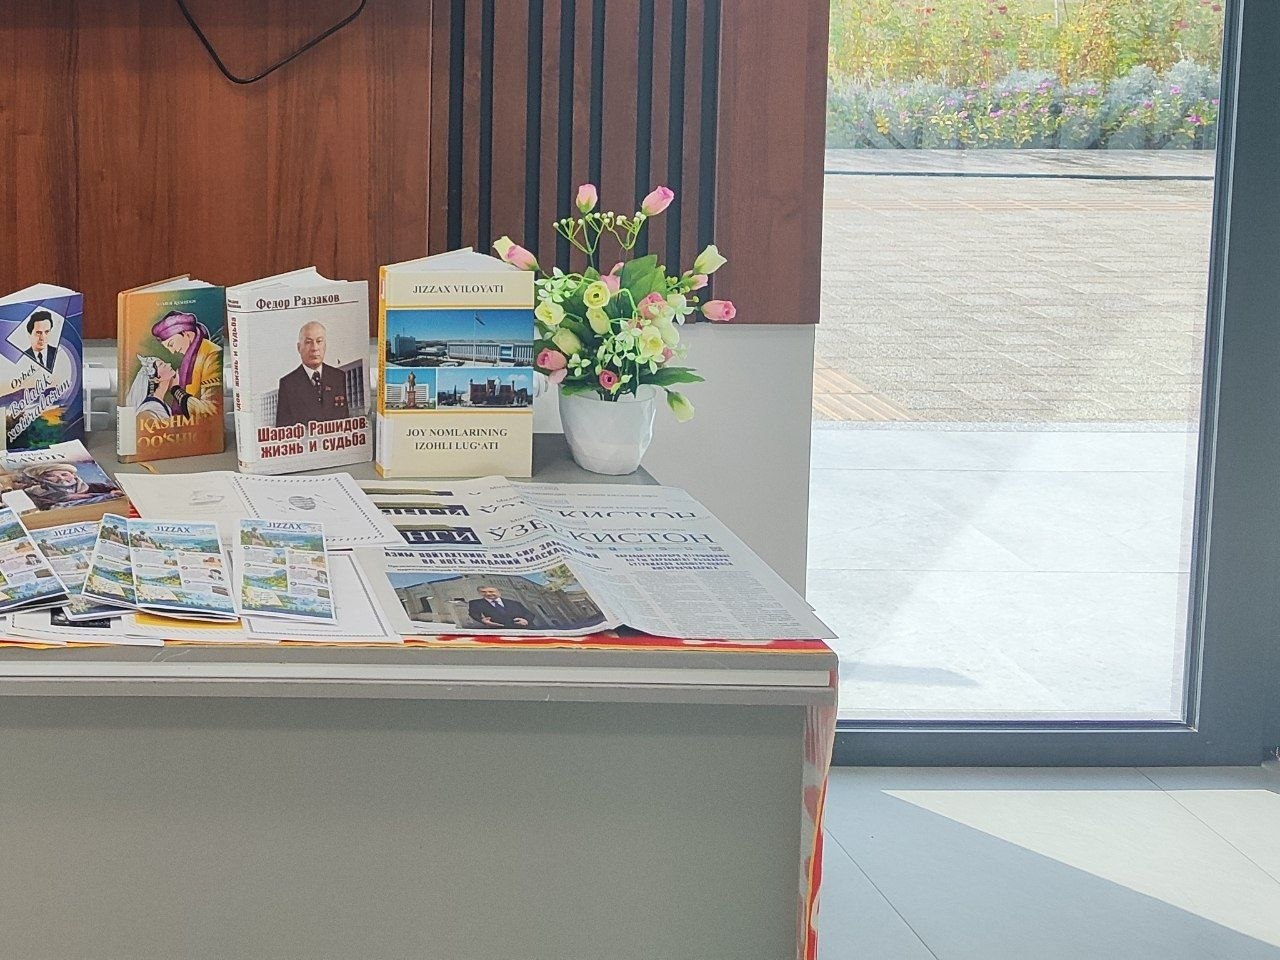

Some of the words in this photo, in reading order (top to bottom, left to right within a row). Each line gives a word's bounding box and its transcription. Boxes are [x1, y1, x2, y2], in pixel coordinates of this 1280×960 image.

[412, 285, 451, 294] JIZZAX
[453, 284, 504, 294] VILOYATI
[256, 296, 290, 311] Федор
[293, 293, 340, 307] Раззаков
[10, 365, 37, 389] Oybek
[256, 425, 306, 444] Шараф
[406, 428, 426, 438] JOY
[429, 427, 508, 438] NOMLARINING
[260, 441, 305, 460] жизнь
[308, 441, 318, 453] и
[322, 431, 367, 453] судьба
[414, 441, 453, 451] IZOHLI
[53, 525, 88, 537] JIZZAX
[154, 525, 191, 534] JIZZAX
[267, 521, 302, 530] JIZZAX
[406, 530, 477, 542] НГИ
